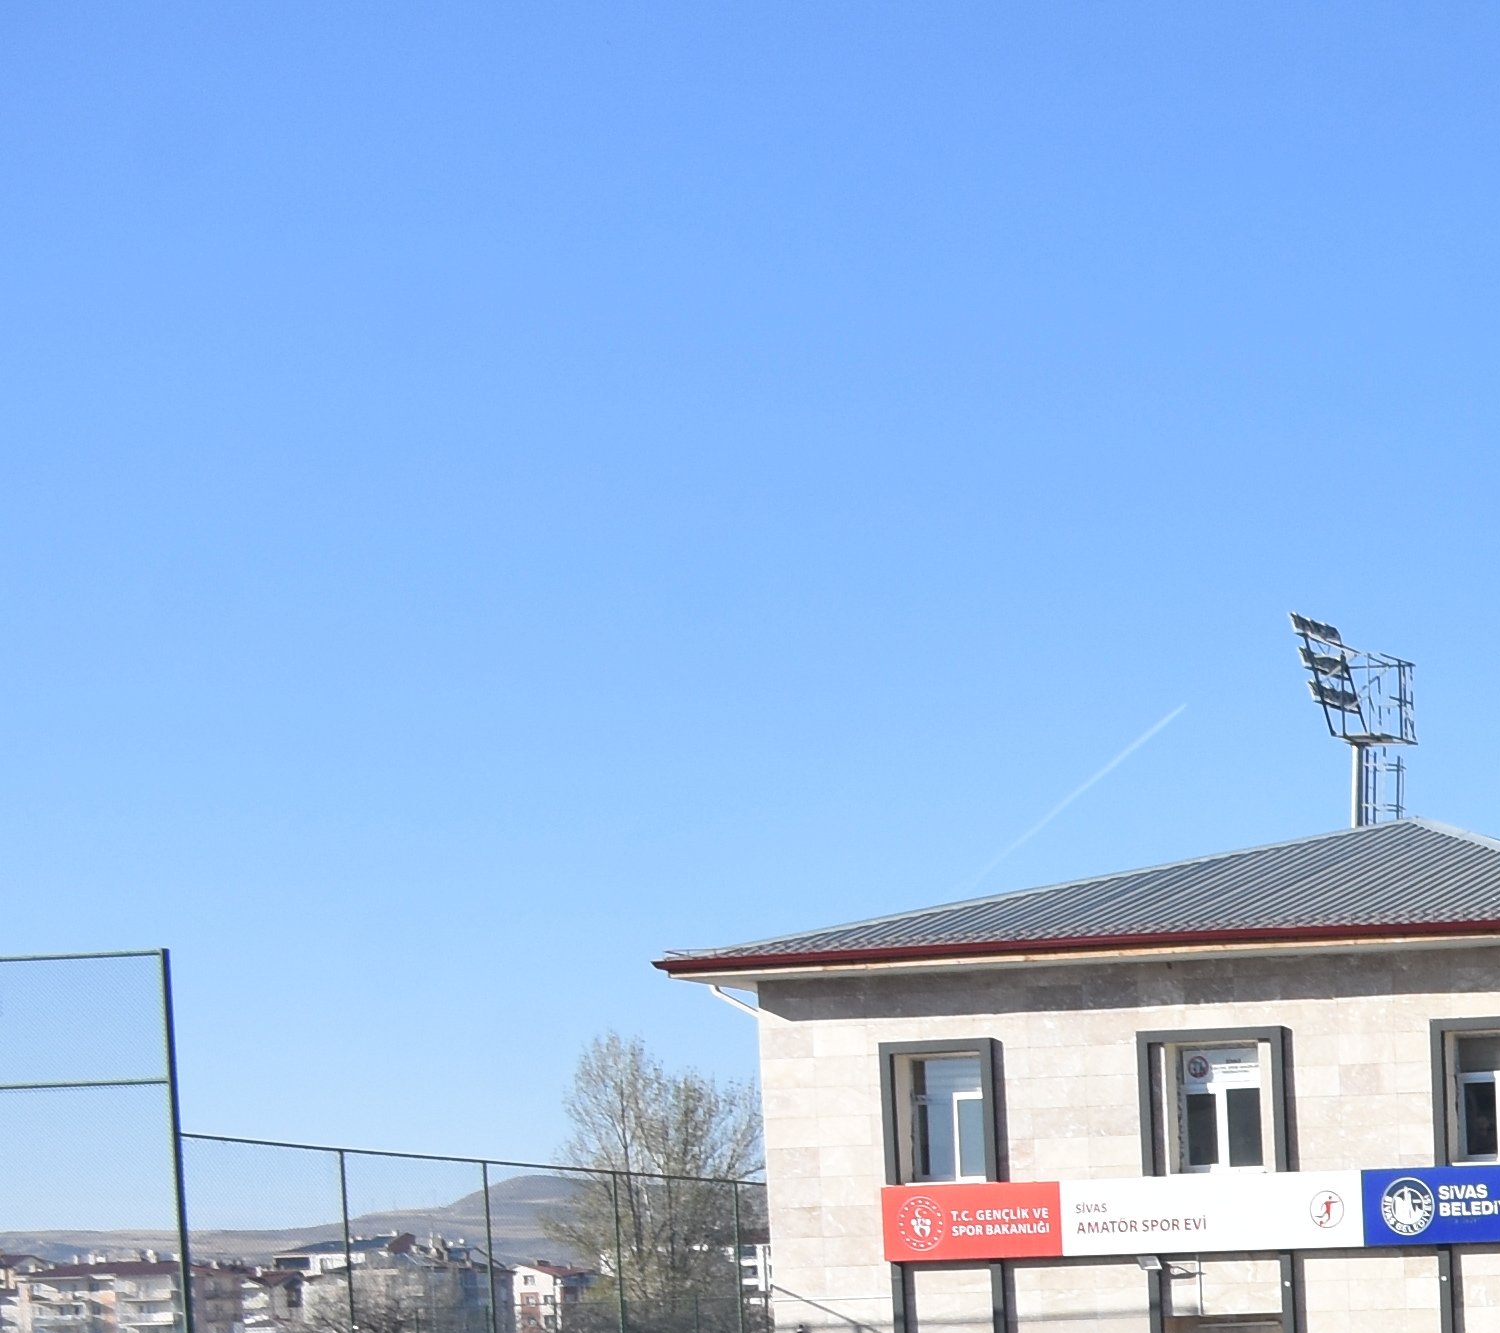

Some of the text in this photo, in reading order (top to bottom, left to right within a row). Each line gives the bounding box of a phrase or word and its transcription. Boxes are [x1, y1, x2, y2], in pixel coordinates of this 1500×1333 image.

[1438, 1183, 1488, 1200] SİVAS
[951, 1206, 1049, 1223] T.C. GENÇLİK VE
[1075, 1201, 1108, 1214] SİVAS
[951, 1221, 1050, 1237] SPOR BAKANLIĞI
[1076, 1214, 1208, 1235] AMATÖR SPOR EVİ
